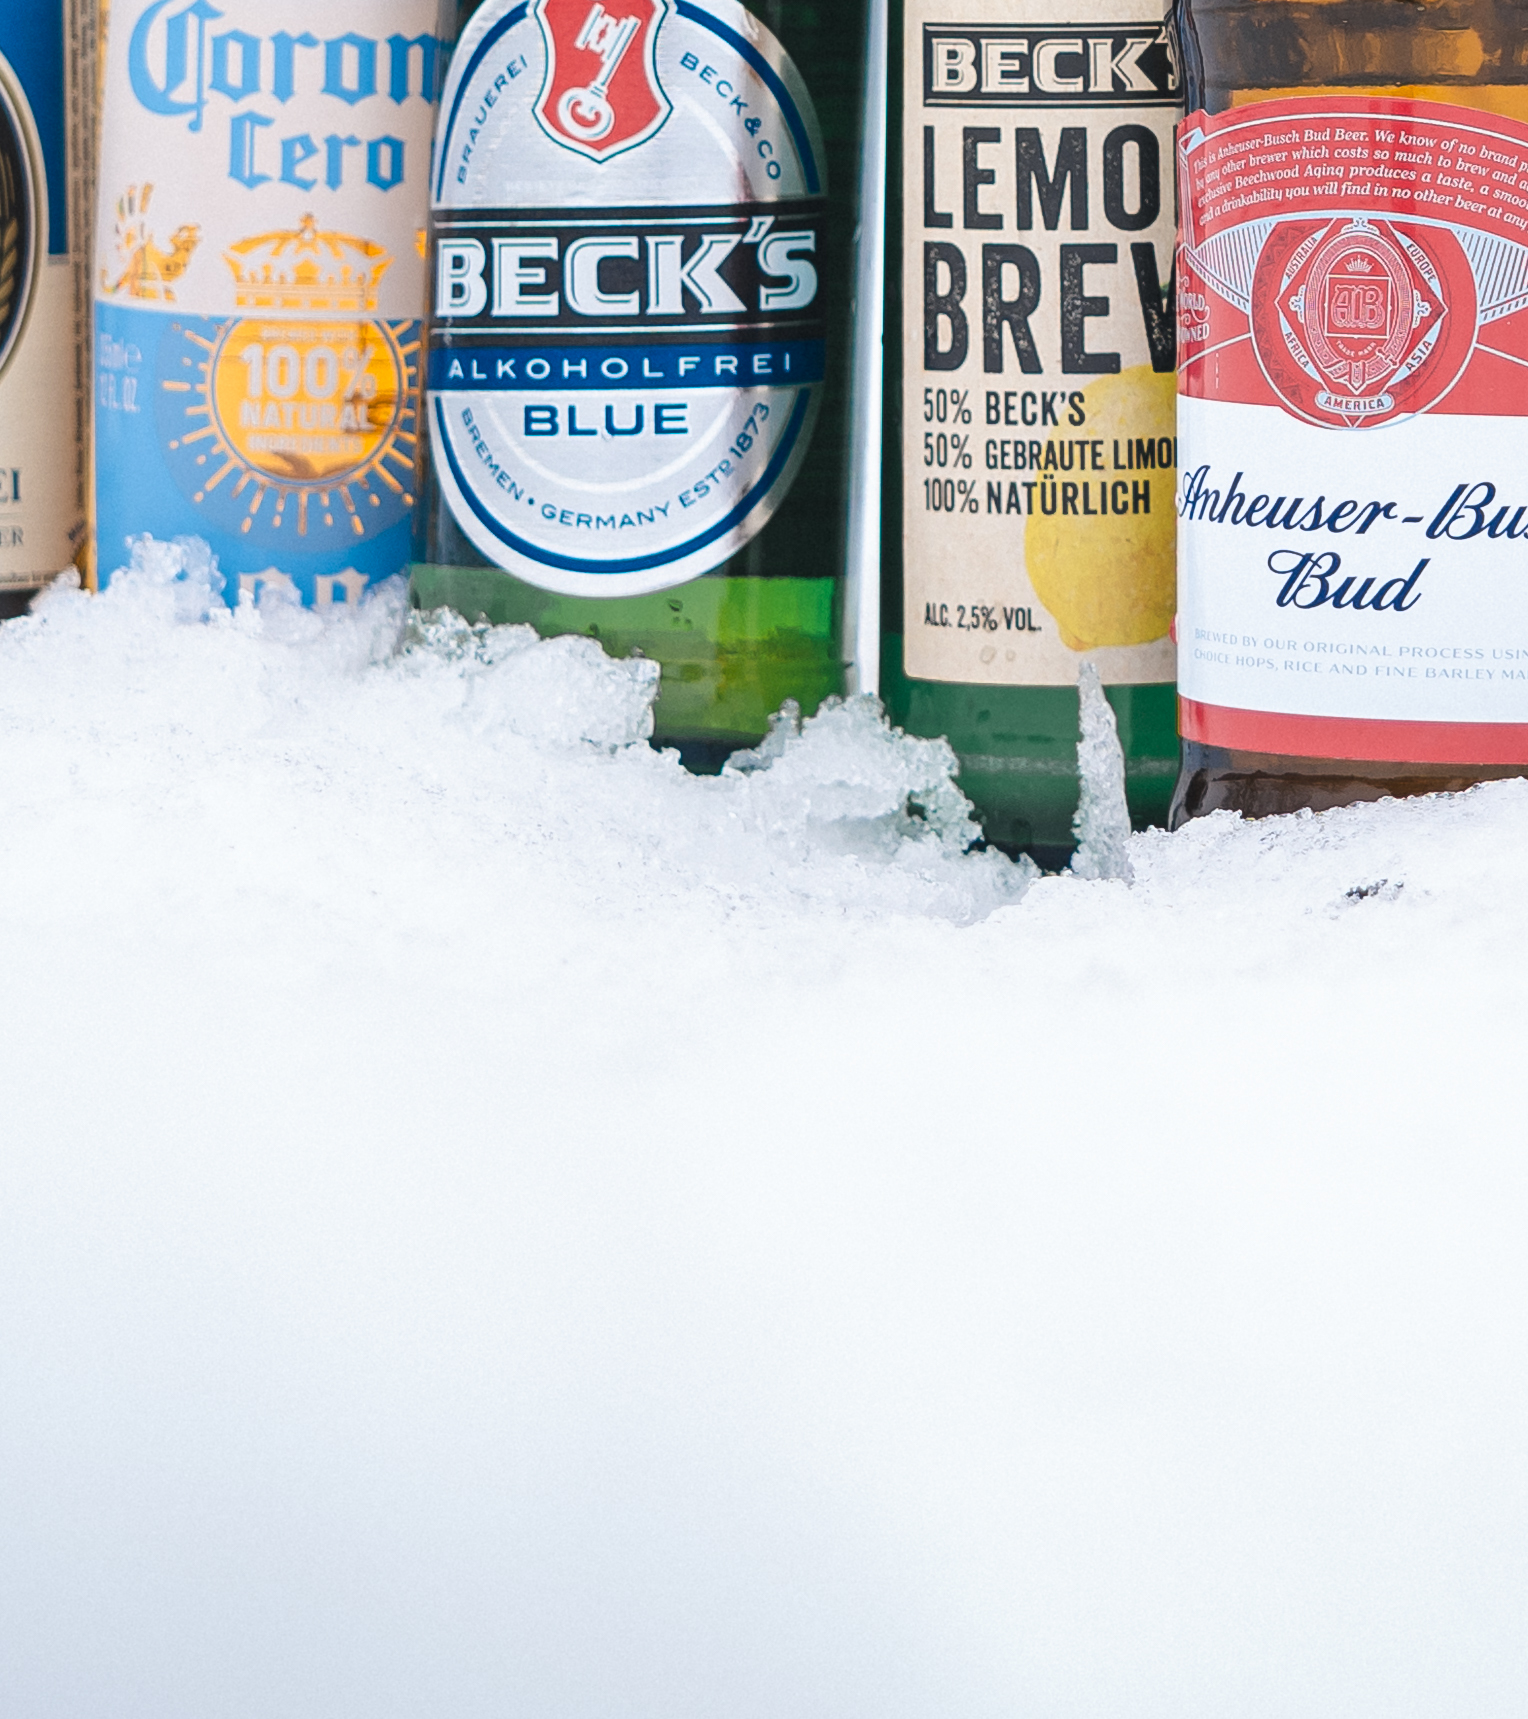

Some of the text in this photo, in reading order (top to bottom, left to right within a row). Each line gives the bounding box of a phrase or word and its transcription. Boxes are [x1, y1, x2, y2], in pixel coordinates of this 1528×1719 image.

[458, 54, 528, 184] BRAUEREI
[228, 111, 406, 193] Cero
[1217, 130, 1301, 160] Anheuser-Busch
[1303, 128, 1330, 143] Bud
[1333, 128, 1370, 142] Beer.
[1375, 129, 1395, 144] We
[1398, 130, 1437, 149] know
[1479, 144, 1519, 168] brand
[1249, 150, 1288, 167] brewer
[1291, 146, 1330, 160] which
[1333, 147, 1369, 160] costs
[1394, 151, 1433, 166] much
[1456, 157, 1490, 177] brew
[923, 124, 1178, 231] LEMO
[1197, 181, 1233, 209] exclusive
[1235, 165, 1300, 191] Beechwood
[1303, 164, 1344, 180] Aging
[1349, 163, 1417, 181] produces
[1436, 172, 1475, 194] taste,
[1221, 188, 1283, 215] drinkability
[1285, 184, 1310, 201] you
[1313, 182, 1338, 196] will
[1340, 181, 1371, 199] find
[1413, 188, 1453, 206] other
[1454, 194, 1487, 214] beer
[435, 215, 818, 318] BECK'S
[1285, 236, 1319, 280] AUSTRALIA
[1406, 242, 1437, 283] EUROPE
[449, 352, 791, 379] ALKOHOLFREI
[1283, 331, 1310, 369] AFRICA
[1404, 339, 1433, 372] ASIA
[241, 343, 377, 399] 100%
[240, 401, 376, 430] NATURAL
[524, 403, 690, 437] BLUE
[923, 387, 1086, 427] 50% BECK'S
[1324, 397, 1386, 412] AMERICA
[461, 407, 525, 502] BREMEN
[541, 502, 671, 530] GERMANY
[730, 400, 771, 460] 1873
[923, 432, 972, 469] 50%
[985, 439, 1105, 470] GEBRAUTE
[923, 474, 1151, 515] 100% NATÜRLICH
[1267, 549, 1432, 612] Bud
[924, 602, 1042, 632] ALC. 2,5% VOL.
[1193, 647, 1230, 666] CHOICE
[1235, 654, 1279, 672] HOPS,
[1284, 659, 1323, 674] RICE
[1329, 662, 1368, 676] AND
[1375, 665, 1418, 678] FINE
[1425, 665, 1494, 680] BARLEY
[1194, 627, 1238, 646] BREWED
[1242, 635, 1258, 648] BY
[1263, 637, 1298, 652] OUR
[1303, 640, 1393, 657] ORIGINAL
[1398, 646, 1485, 660] PROCESS
